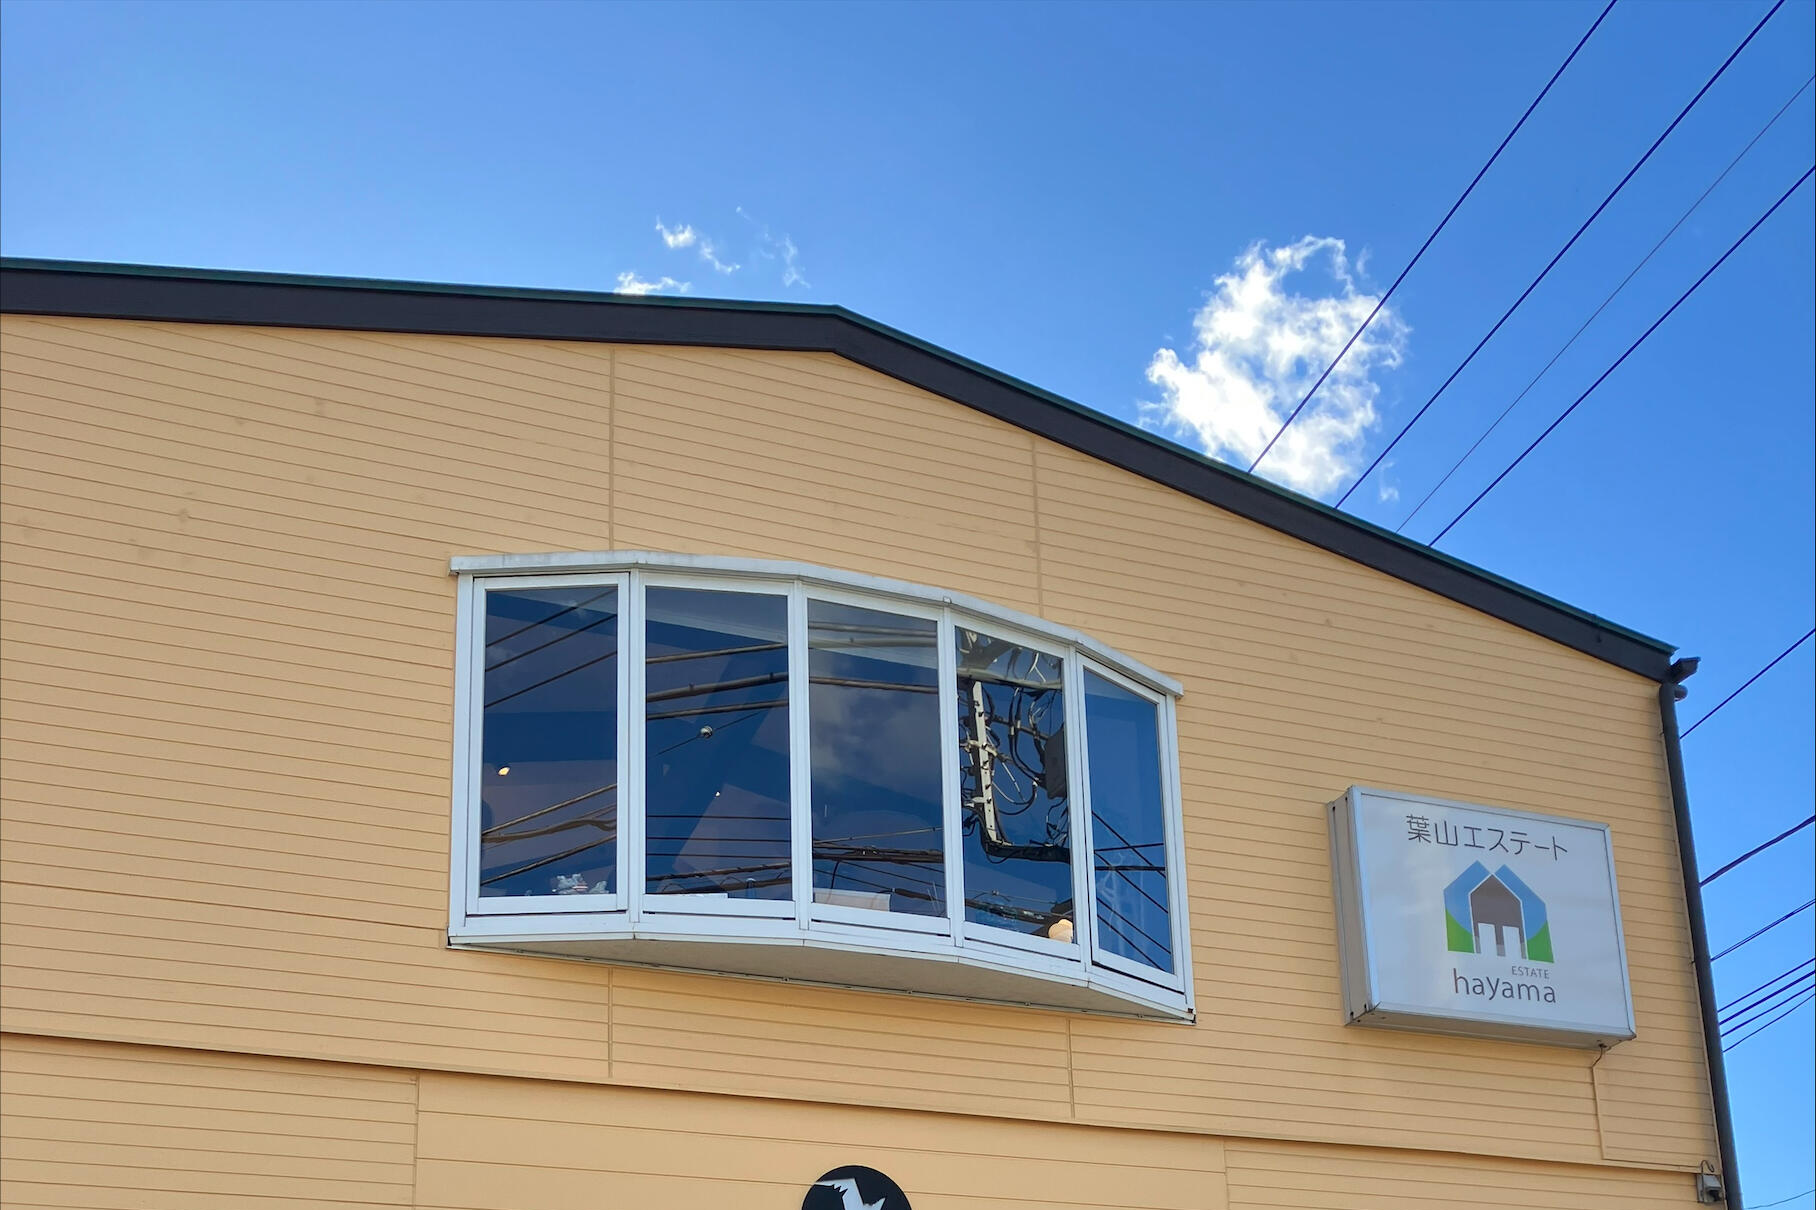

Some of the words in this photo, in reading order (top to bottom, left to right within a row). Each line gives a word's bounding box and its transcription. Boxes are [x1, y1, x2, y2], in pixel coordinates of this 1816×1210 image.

[1406, 814, 1568, 861] 葉山エステート
[1453, 968, 1557, 1004] hayama
[1511, 966, 1550, 980] ESTATE
